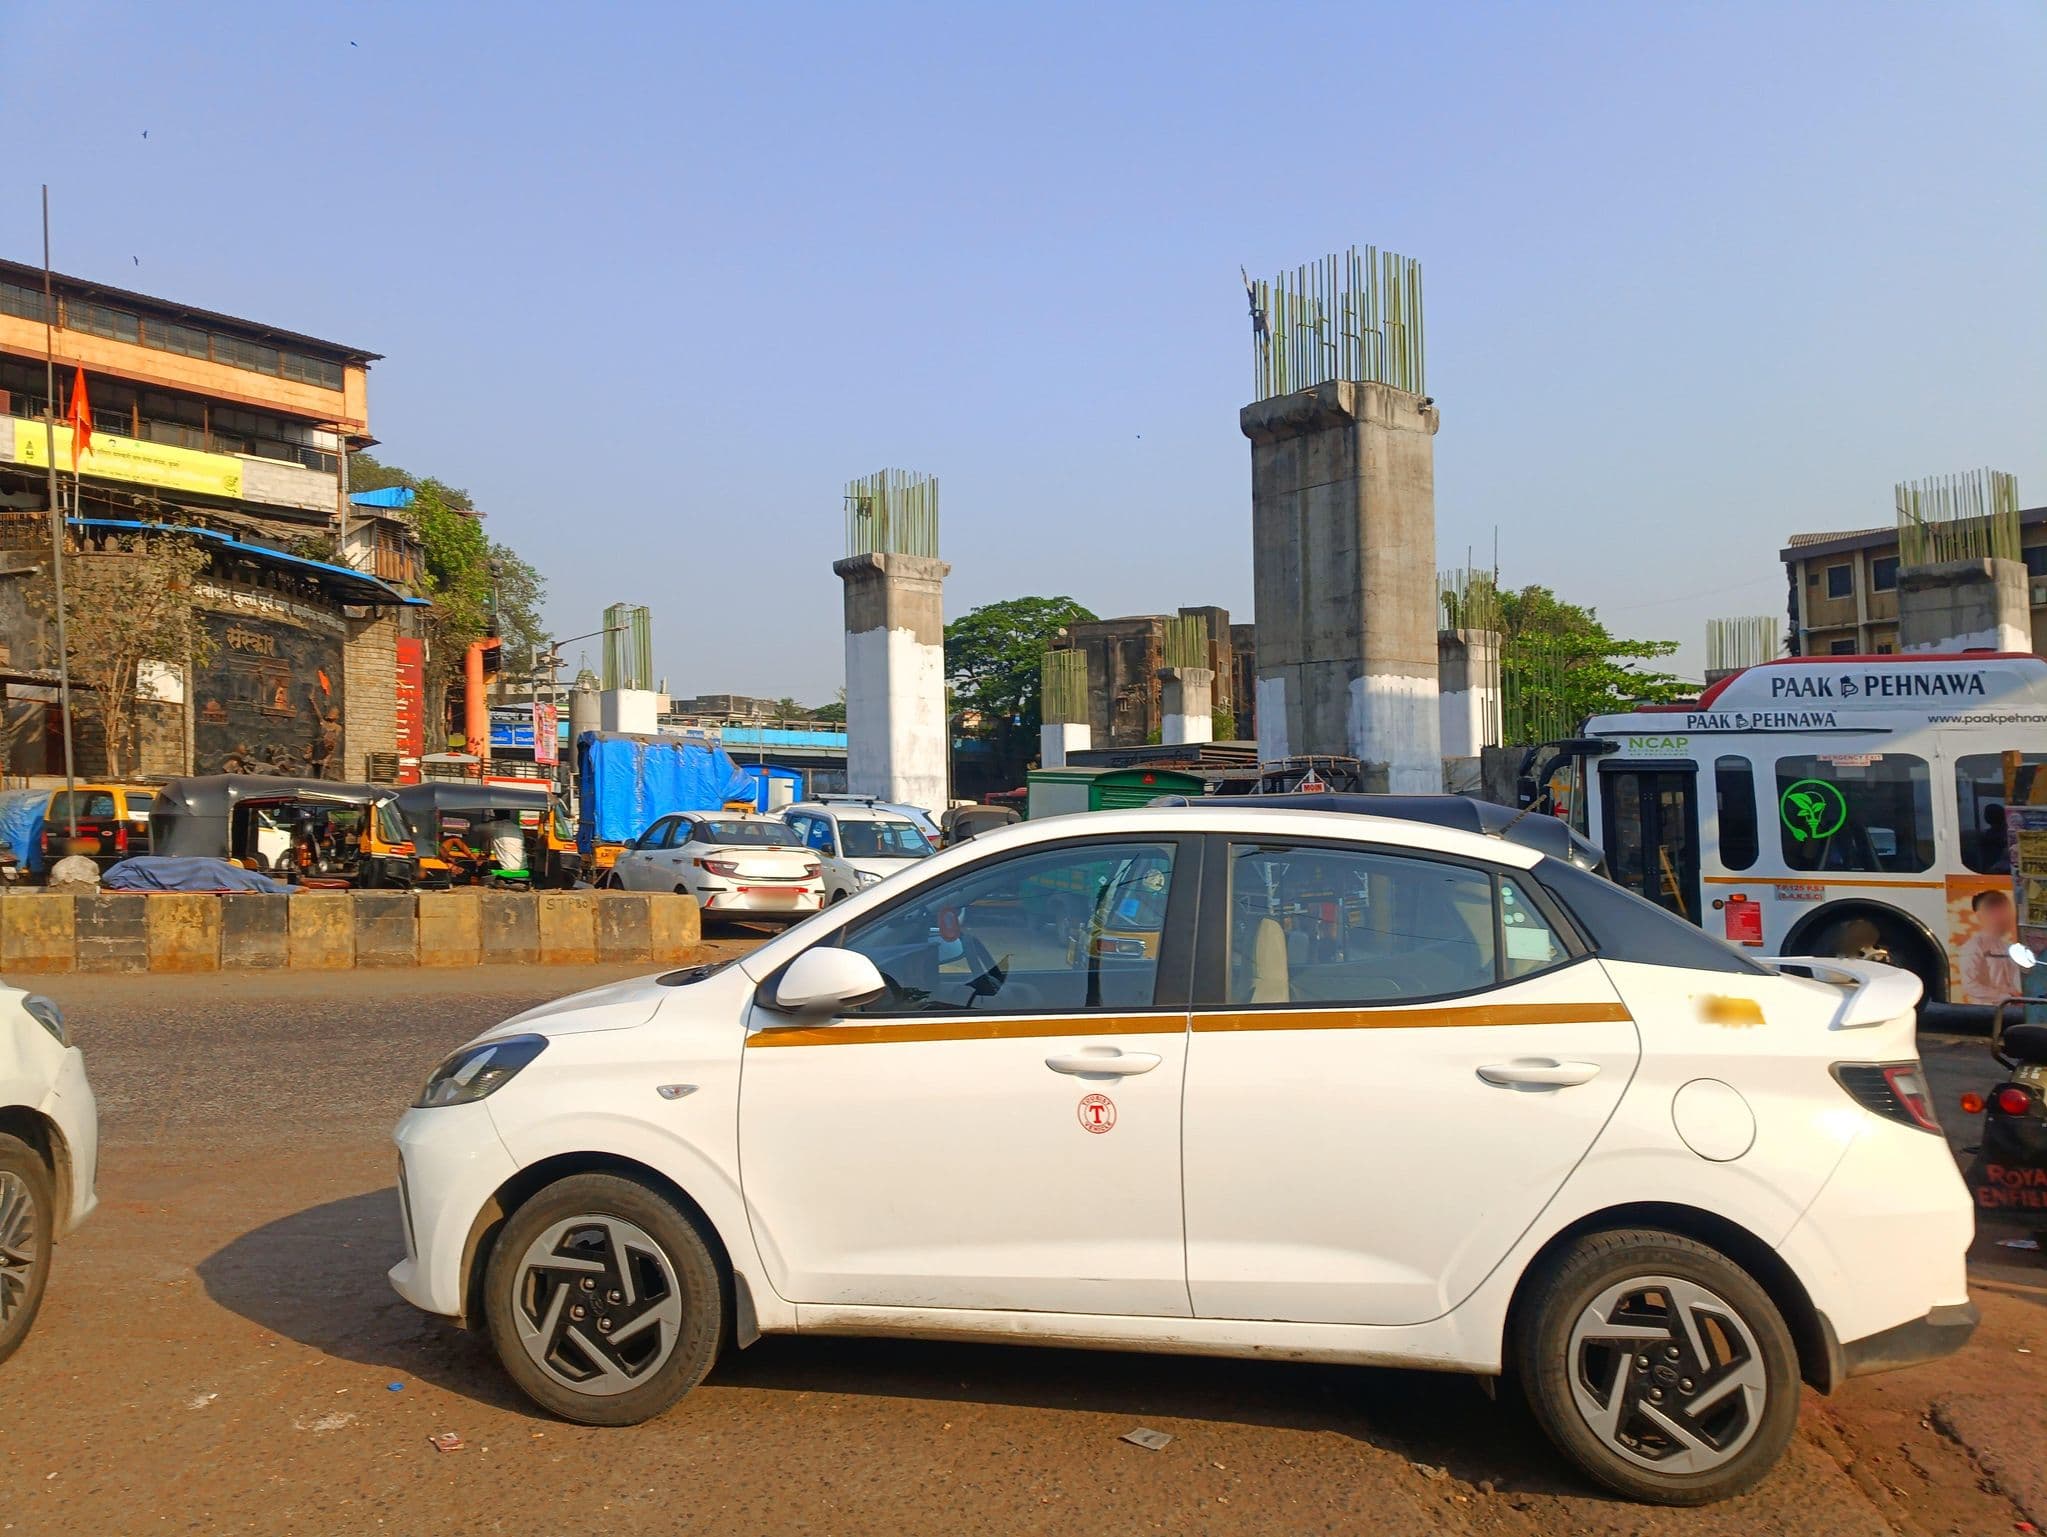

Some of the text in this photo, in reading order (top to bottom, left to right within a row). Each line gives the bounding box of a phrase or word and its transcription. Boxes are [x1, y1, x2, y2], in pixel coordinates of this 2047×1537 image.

[226, 623, 275, 658] संस्कार
[1771, 673, 1986, 698] PAAK PEHNAWA
[1687, 712, 1837, 729] PAAK PEHNAWA
[1629, 737, 1688, 748] NCAP
[1089, 1105, 1105, 1124] T
